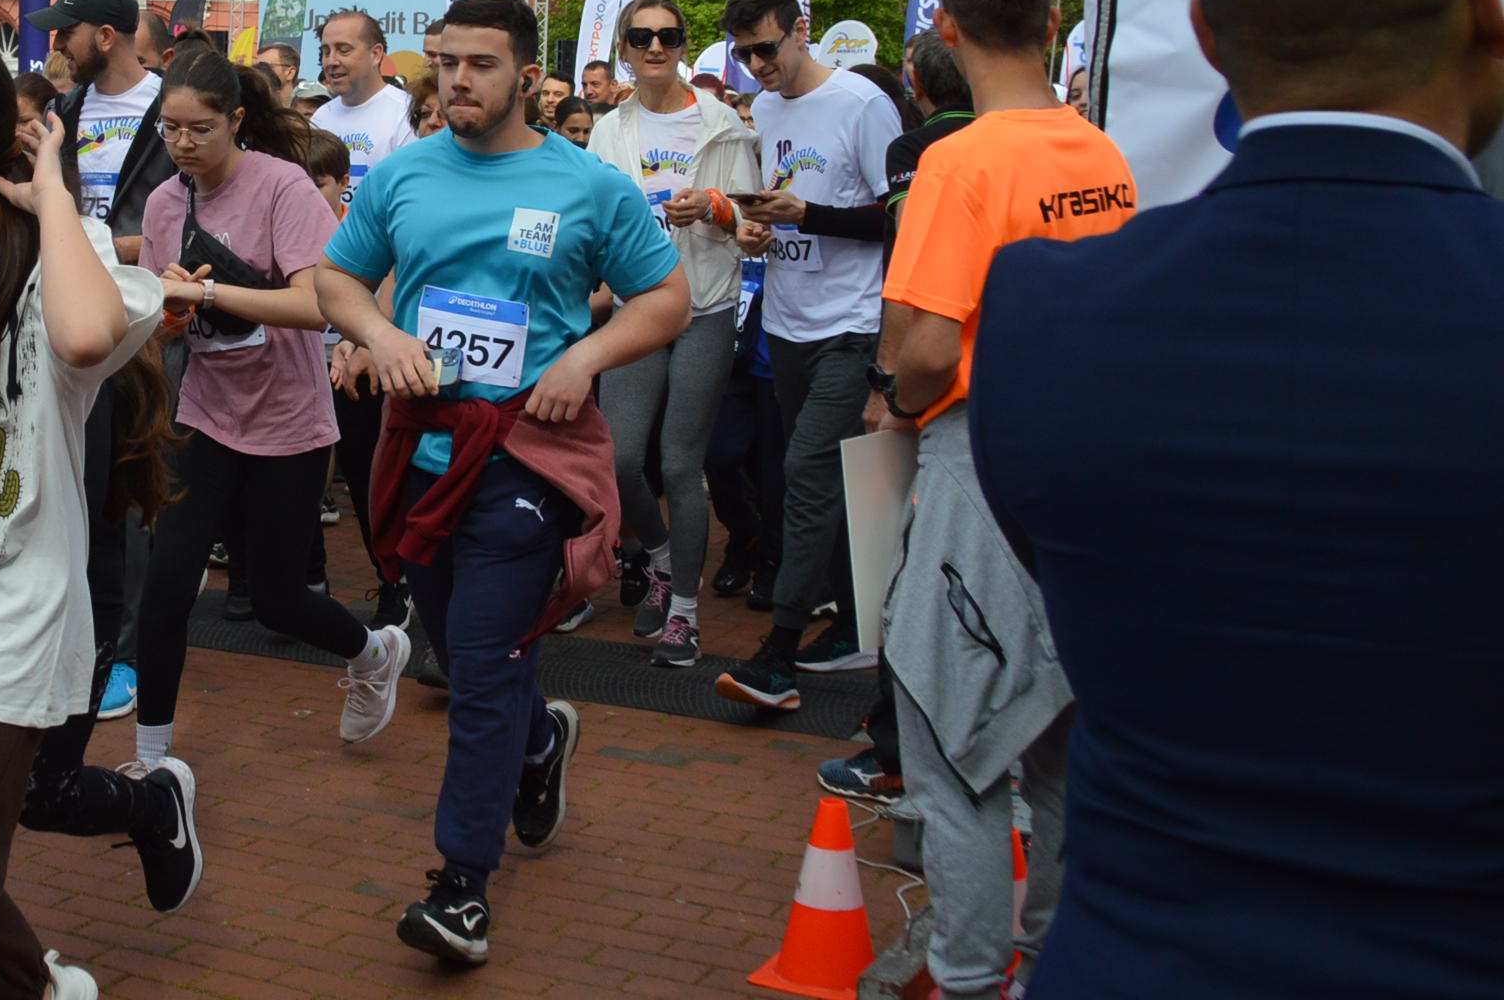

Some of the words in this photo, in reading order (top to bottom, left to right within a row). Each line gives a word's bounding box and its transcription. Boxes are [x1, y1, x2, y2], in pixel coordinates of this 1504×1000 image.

[339, 132, 375, 150] arathon
[780, 146, 828, 173] Marathon
[82, 196, 110, 220] 75
[534, 222, 554, 234] AM
[551, 215, 556, 225] I
[519, 228, 553, 244] TEAM
[457, 297, 498, 312] DECATHLON
[425, 326, 516, 370] 4257
